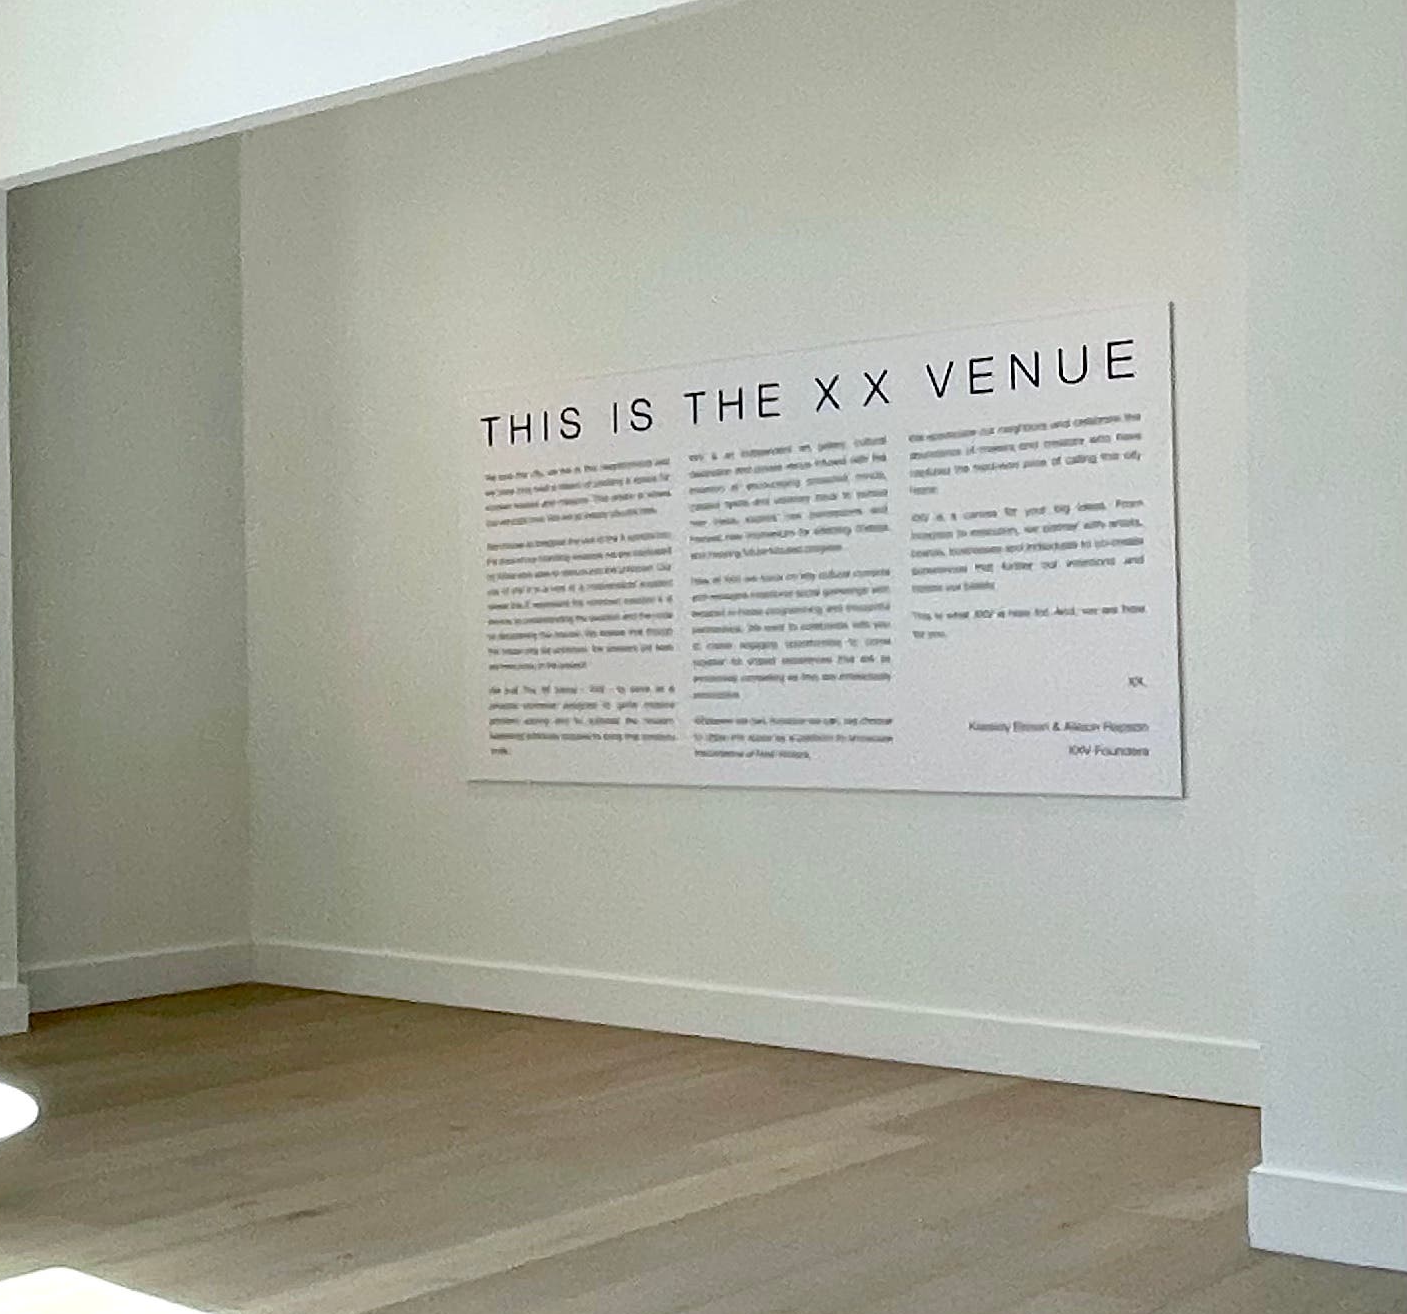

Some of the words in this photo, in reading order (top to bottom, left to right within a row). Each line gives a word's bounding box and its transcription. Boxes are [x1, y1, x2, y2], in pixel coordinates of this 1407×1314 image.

[481, 406, 582, 447] THIS
[612, 397, 654, 435] IS
[683, 383, 781, 425] THE
[926, 339, 1136, 399] VENUE
